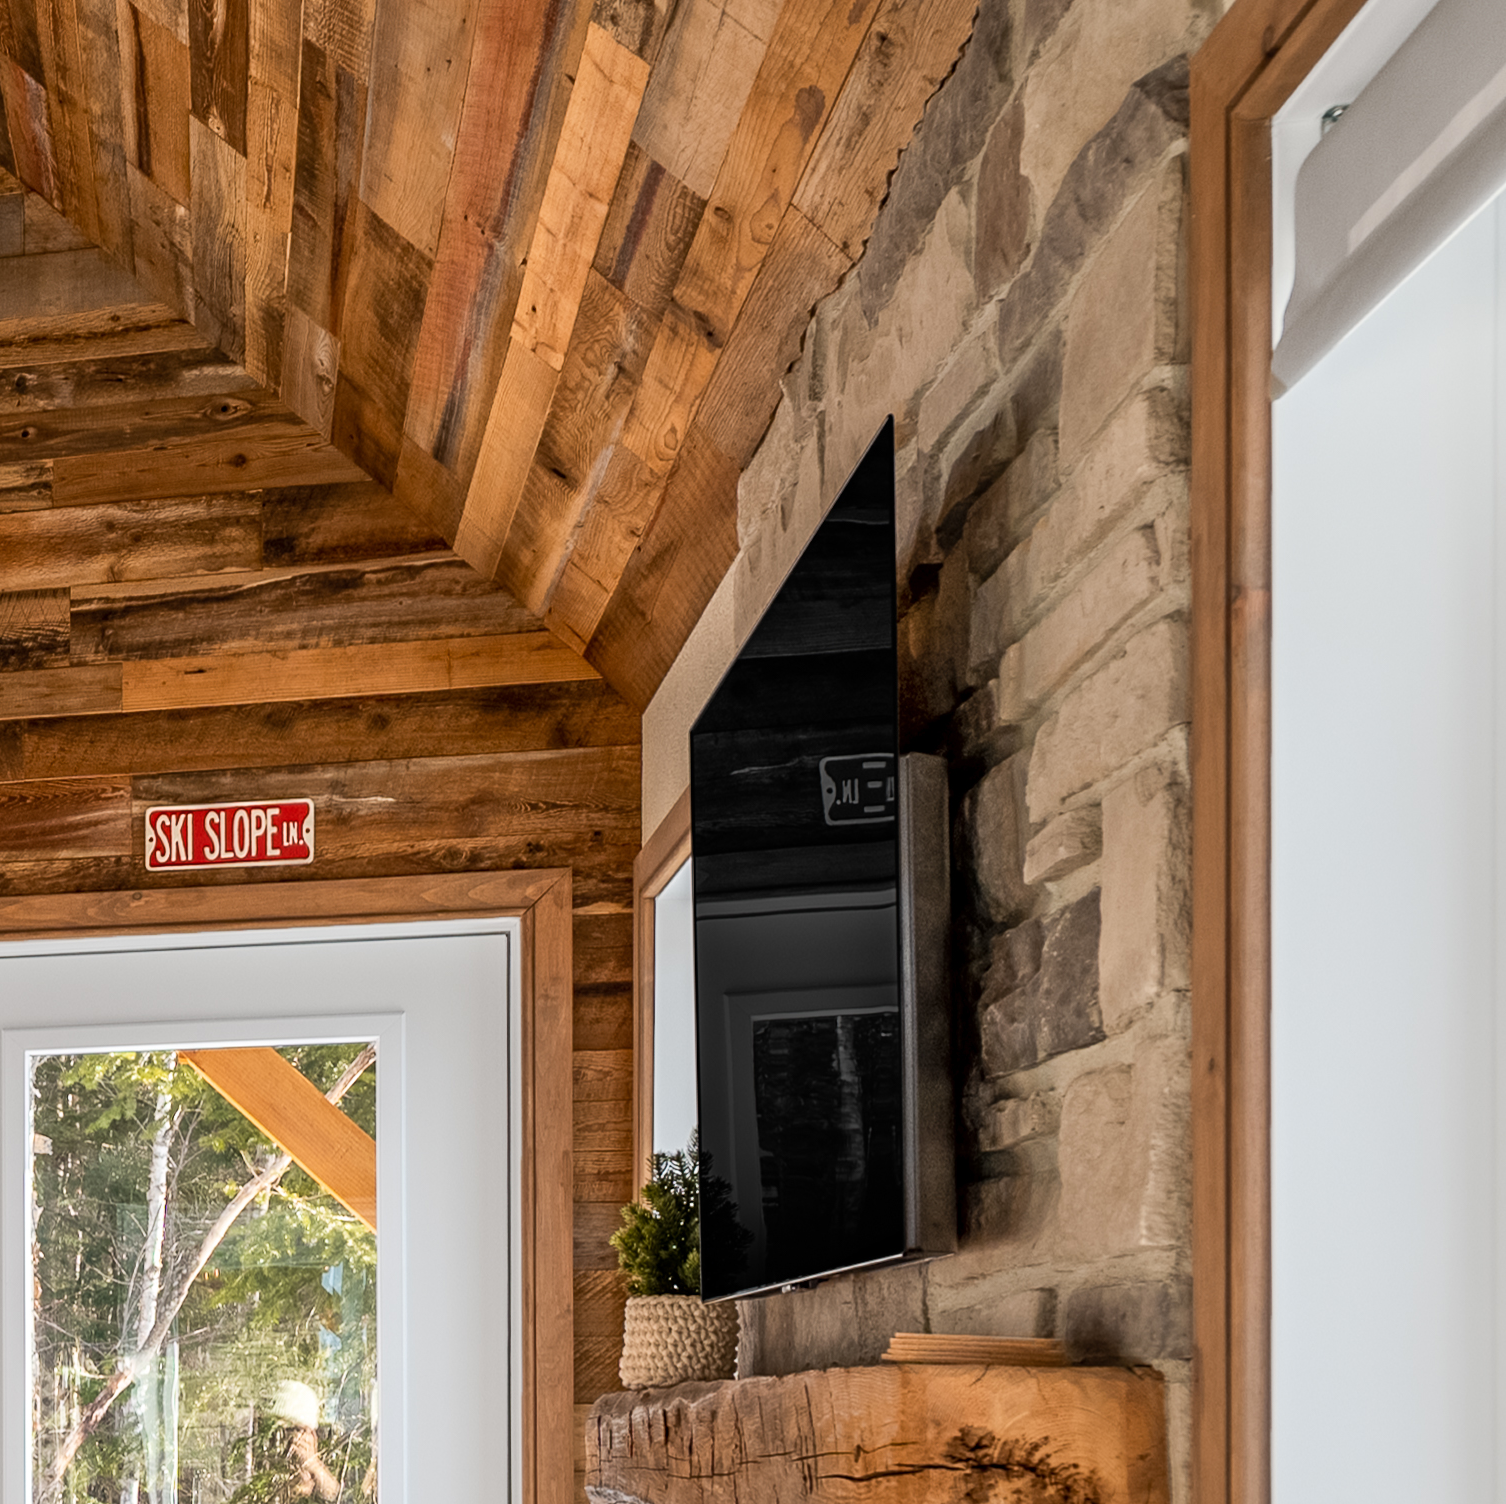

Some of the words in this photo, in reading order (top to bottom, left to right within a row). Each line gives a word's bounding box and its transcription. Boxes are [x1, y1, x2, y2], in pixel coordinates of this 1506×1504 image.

[156, 813, 193, 863] SKI
[203, 808, 281, 860] SLOPE
[283, 821, 304, 846] LN.
